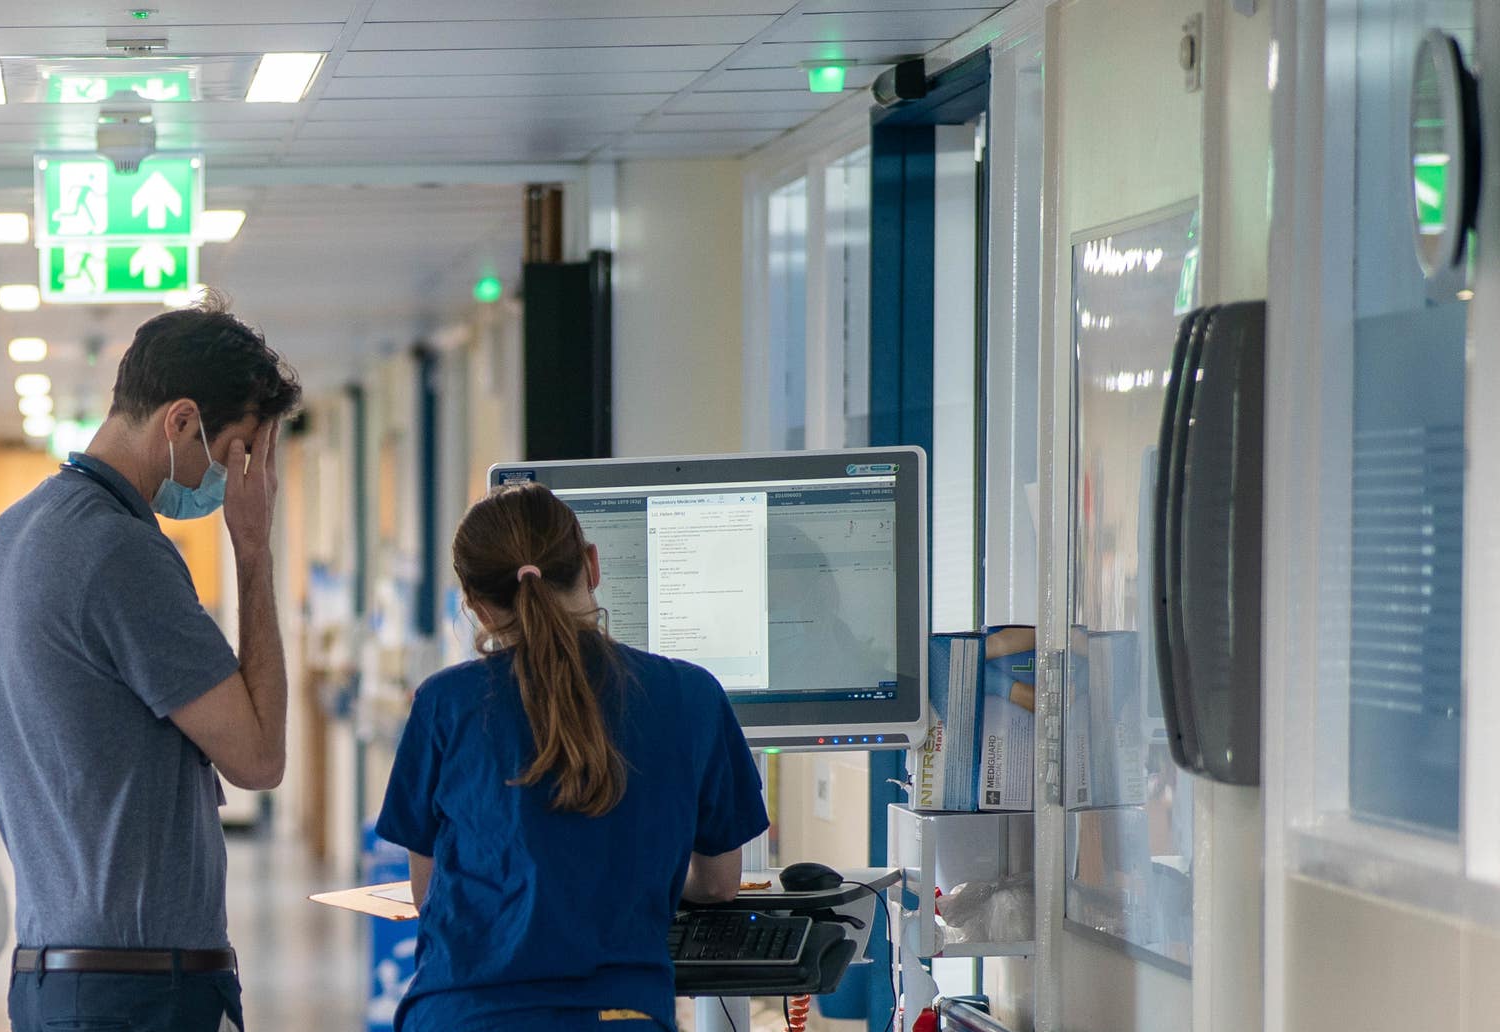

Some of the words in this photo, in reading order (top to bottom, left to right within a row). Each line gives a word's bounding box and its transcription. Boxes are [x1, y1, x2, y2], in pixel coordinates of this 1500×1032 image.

[1012, 658, 1034, 672] L
[920, 725, 937, 807] NITREX
[986, 735, 997, 788] MEDIGUARD
